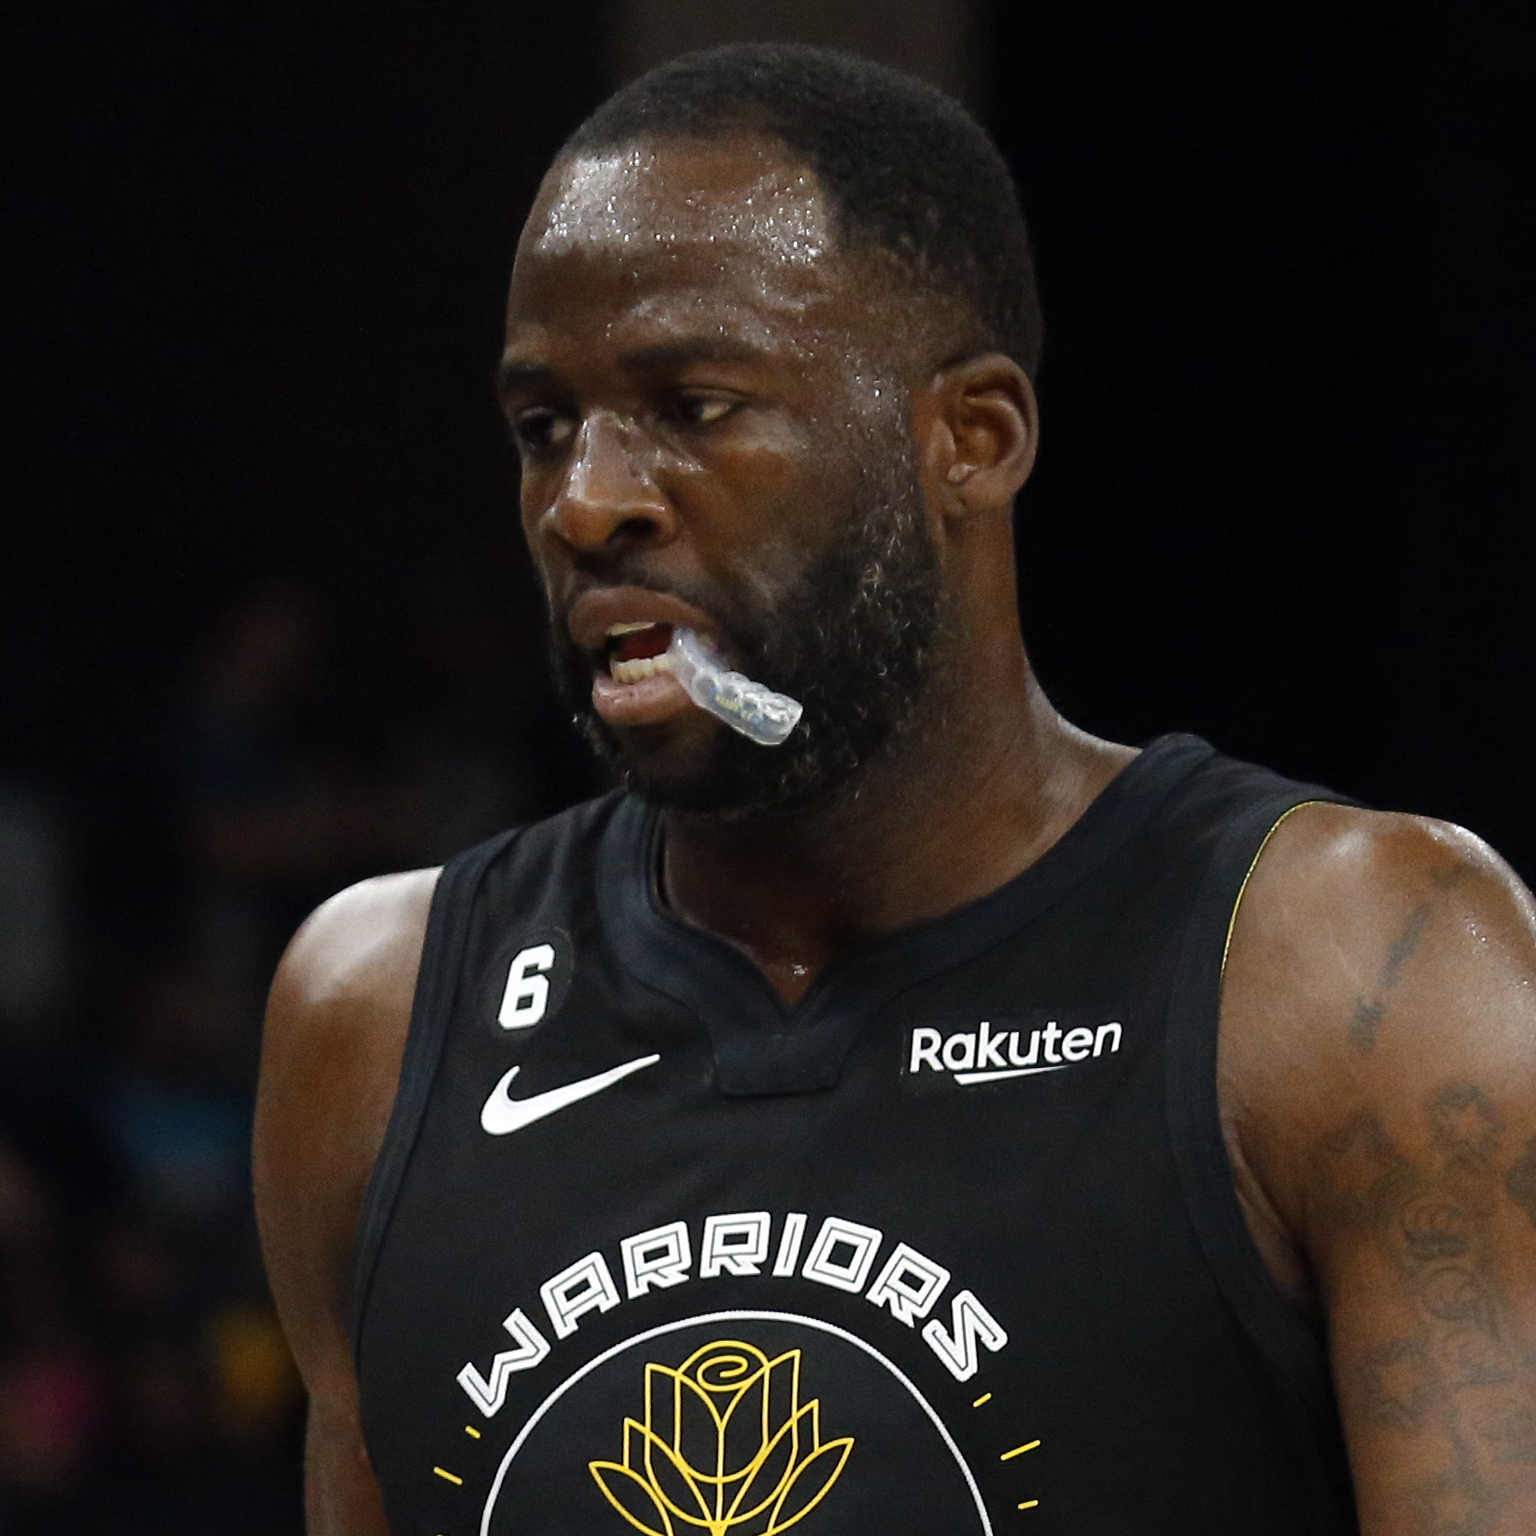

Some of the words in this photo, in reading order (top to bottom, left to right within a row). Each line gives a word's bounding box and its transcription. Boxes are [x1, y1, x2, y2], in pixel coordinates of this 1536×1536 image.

[497, 943, 555, 1030] 6
[909, 1021, 1123, 1074] Rakuten
[456, 1211, 1008, 1418] WARRIORS
